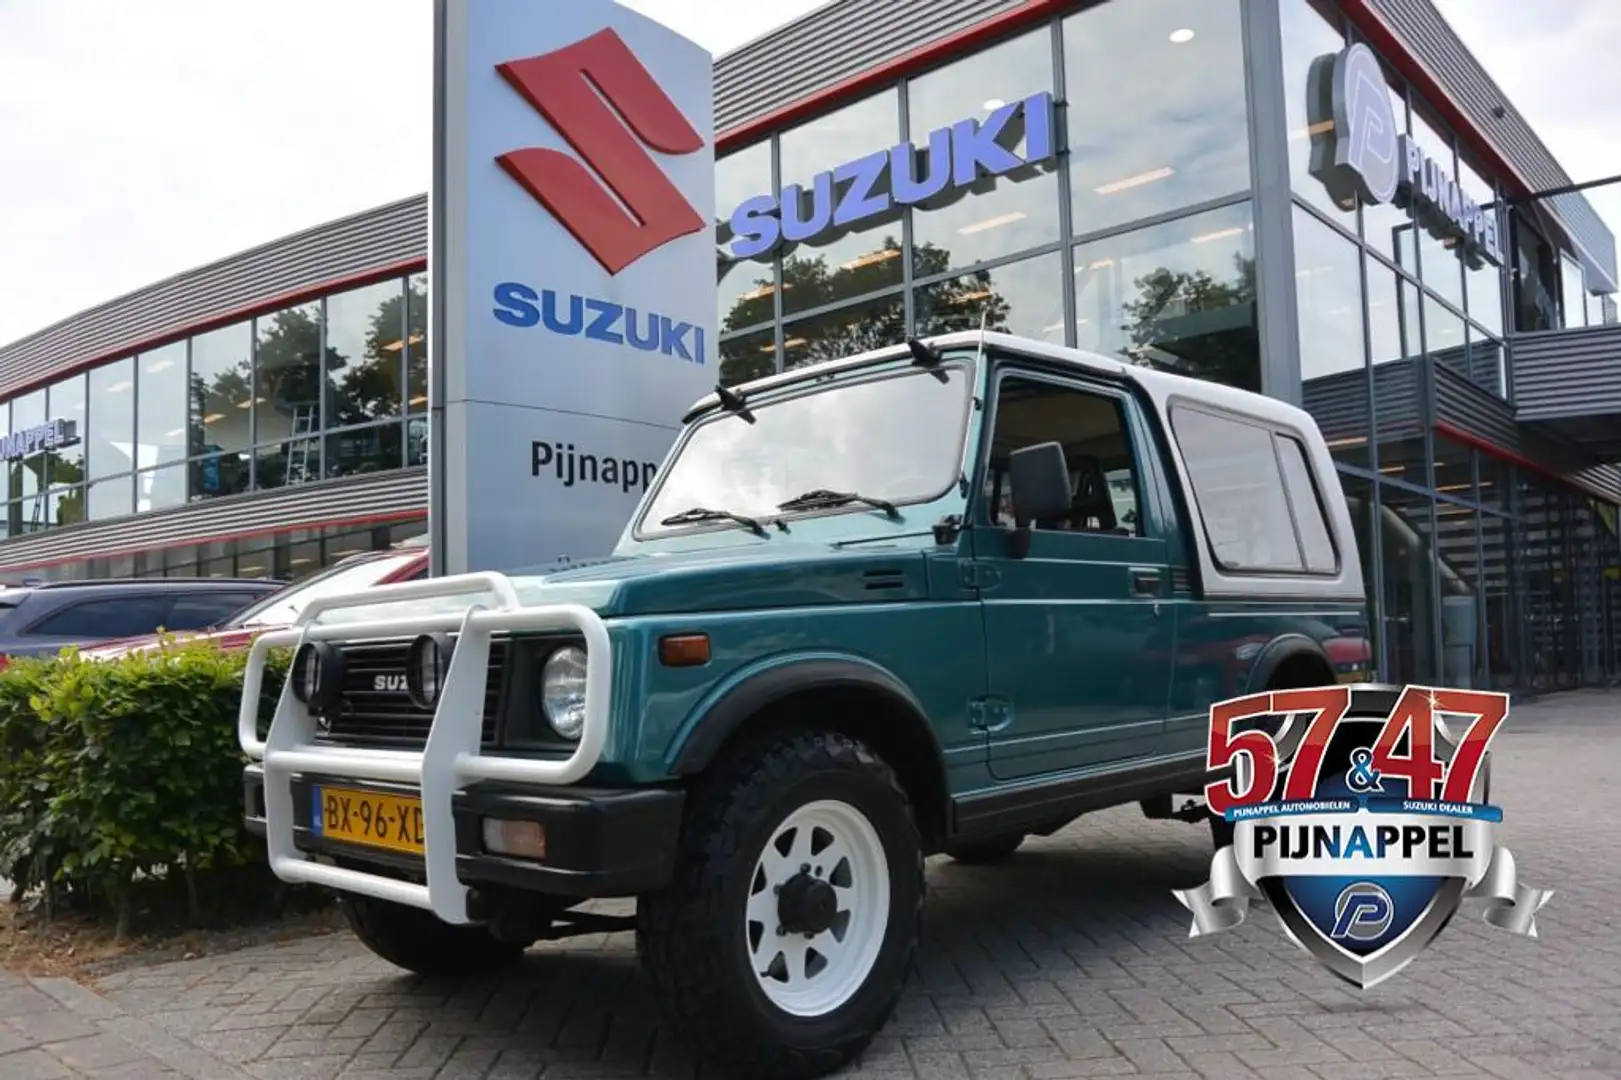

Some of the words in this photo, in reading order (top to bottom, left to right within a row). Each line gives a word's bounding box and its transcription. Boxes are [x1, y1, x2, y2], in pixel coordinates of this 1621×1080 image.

[728, 91, 1053, 259] SUZUKI
[492, 281, 705, 365] SUZUKI
[531, 440, 658, 494] Pijnapp
